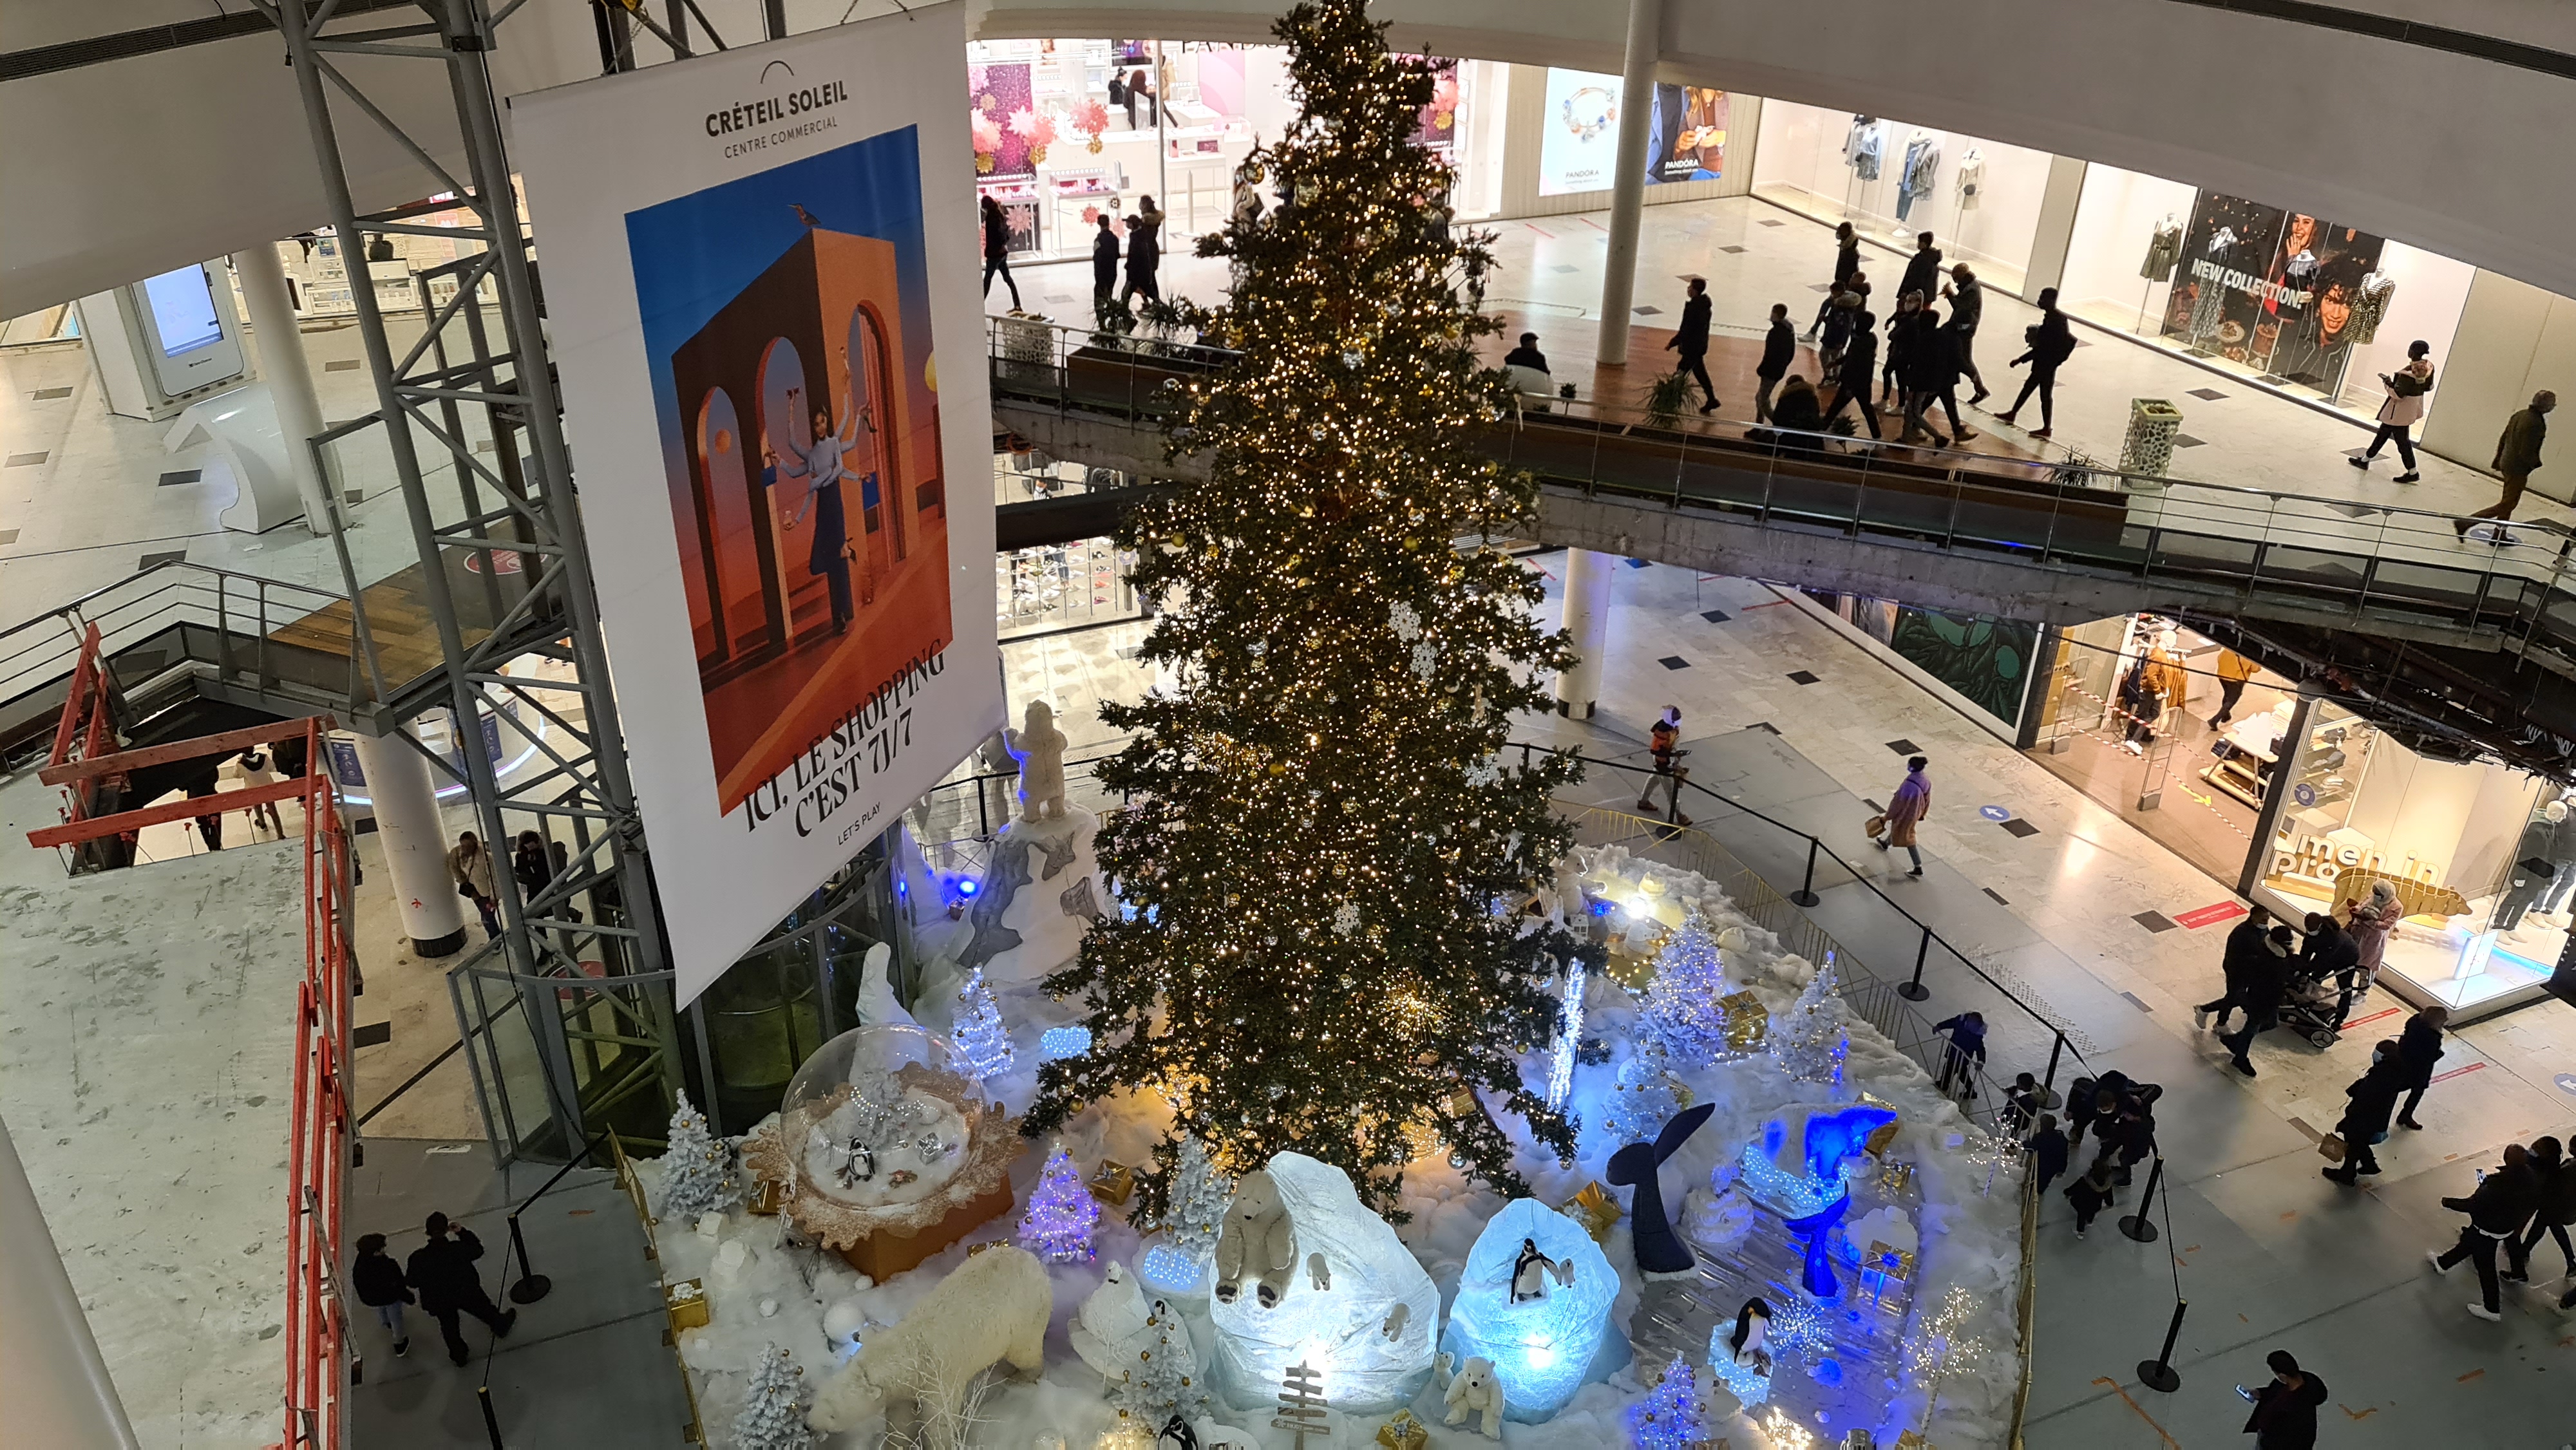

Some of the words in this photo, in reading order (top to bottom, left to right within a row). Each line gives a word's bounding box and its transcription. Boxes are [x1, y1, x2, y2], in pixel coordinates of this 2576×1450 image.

[705, 97, 784, 137] CRÉTEIL
[788, 80, 848, 115] SOLEIL
[724, 136, 767, 158] CENTRE
[771, 116, 838, 145] COMMERCIAL
[2191, 258, 2225, 283] NEW
[743, 772, 788, 833] ICI,
[793, 733, 826, 793] LE
[830, 638, 945, 760] SHOPPING
[795, 751, 862, 838] C'EST
[867, 707, 912, 774] 7J/7
[838, 822, 860, 845] LET'S
[862, 802, 880, 826] PLAY
[2297, 833, 2387, 871] men
[2401, 850, 2440, 885] in
